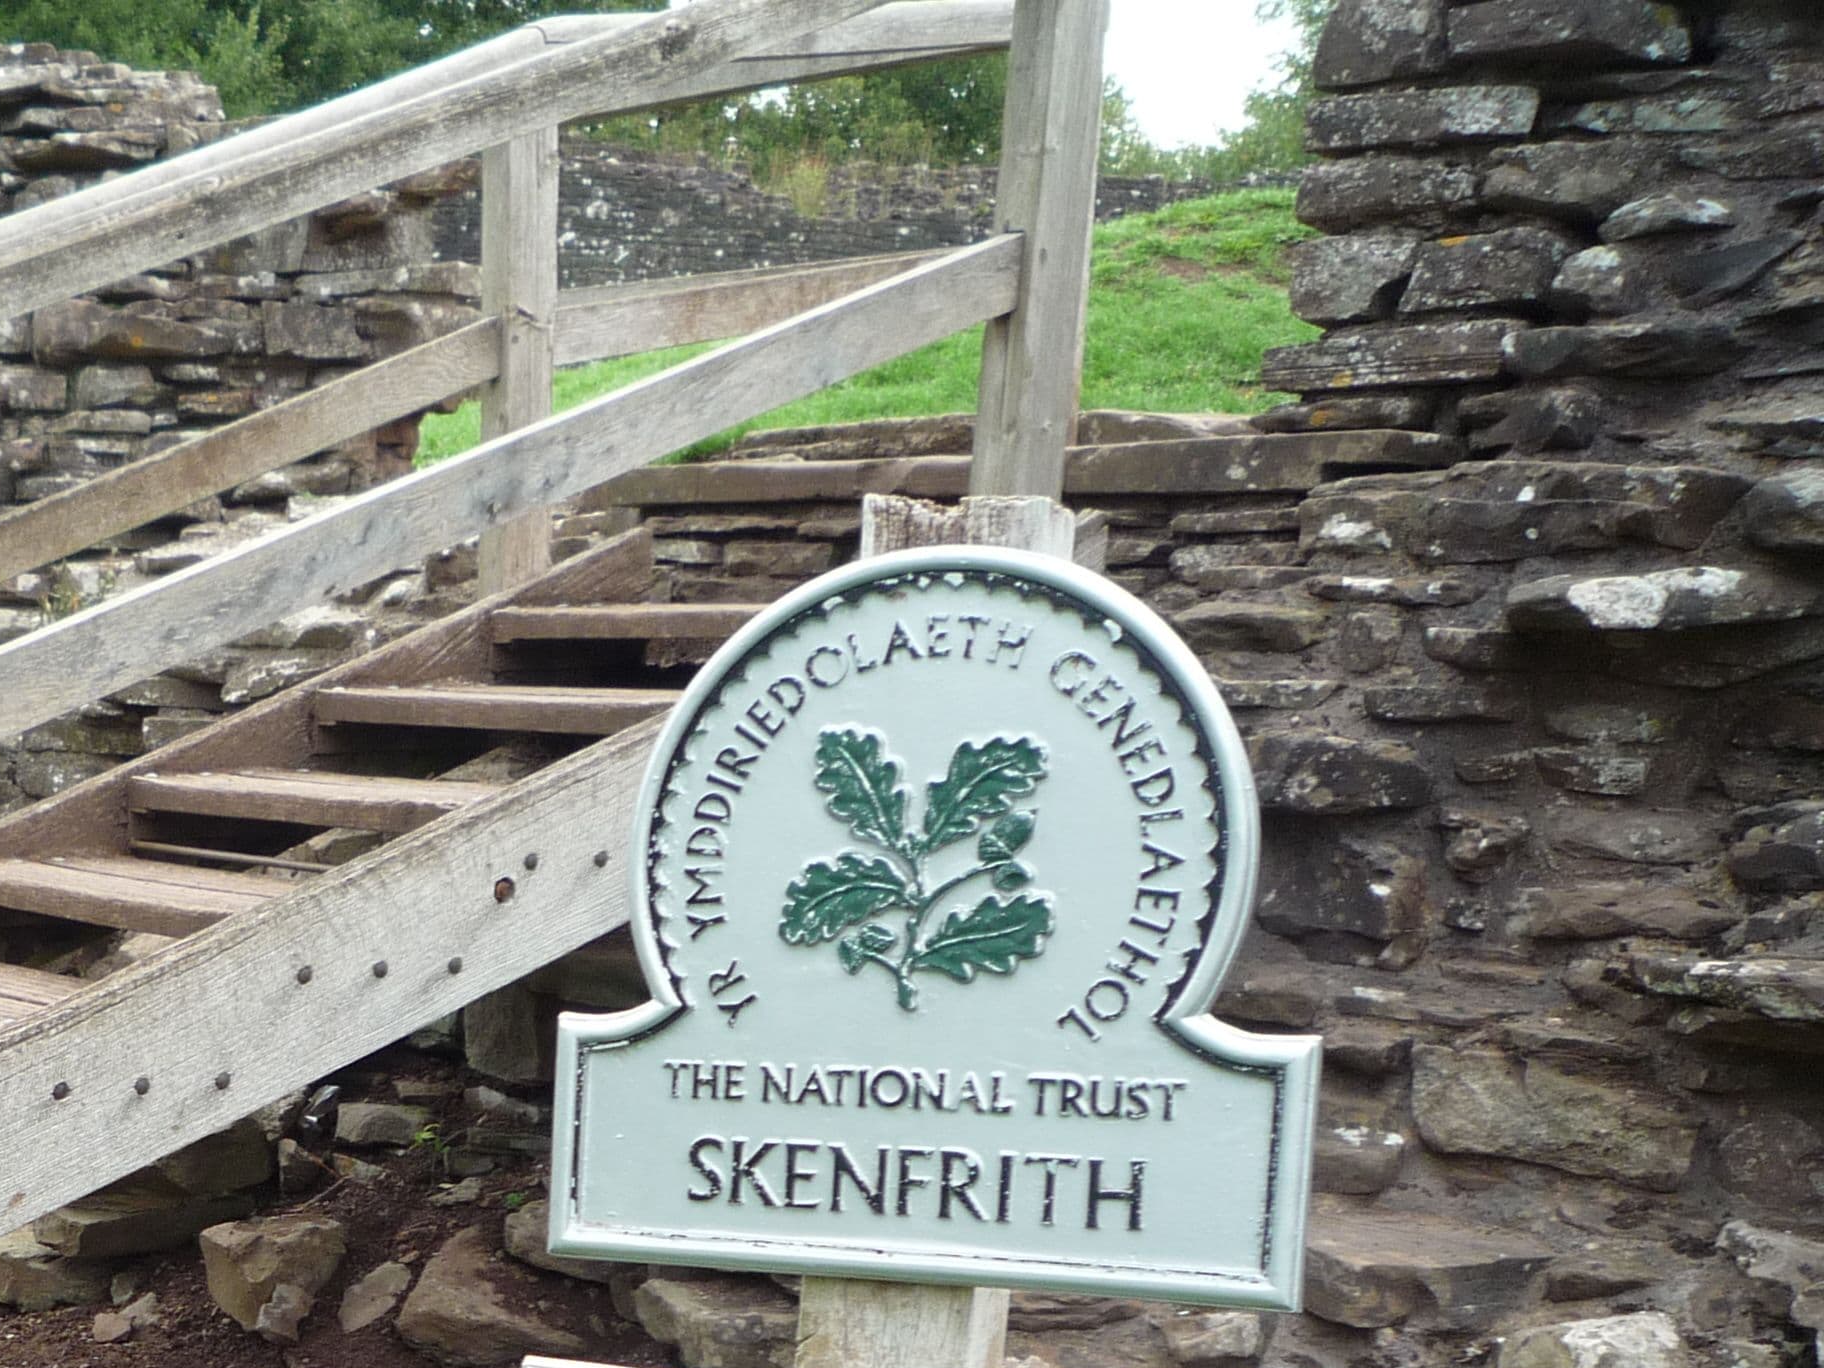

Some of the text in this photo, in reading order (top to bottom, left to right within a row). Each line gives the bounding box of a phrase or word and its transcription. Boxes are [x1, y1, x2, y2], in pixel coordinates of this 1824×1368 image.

[685, 615, 1186, 1041] YR YMDDIRIEDOLAETH GENEDLAETHOL
[663, 1059, 1189, 1124] THE NATIONAL TRUST
[687, 1134, 1148, 1232] SKENFRITH
